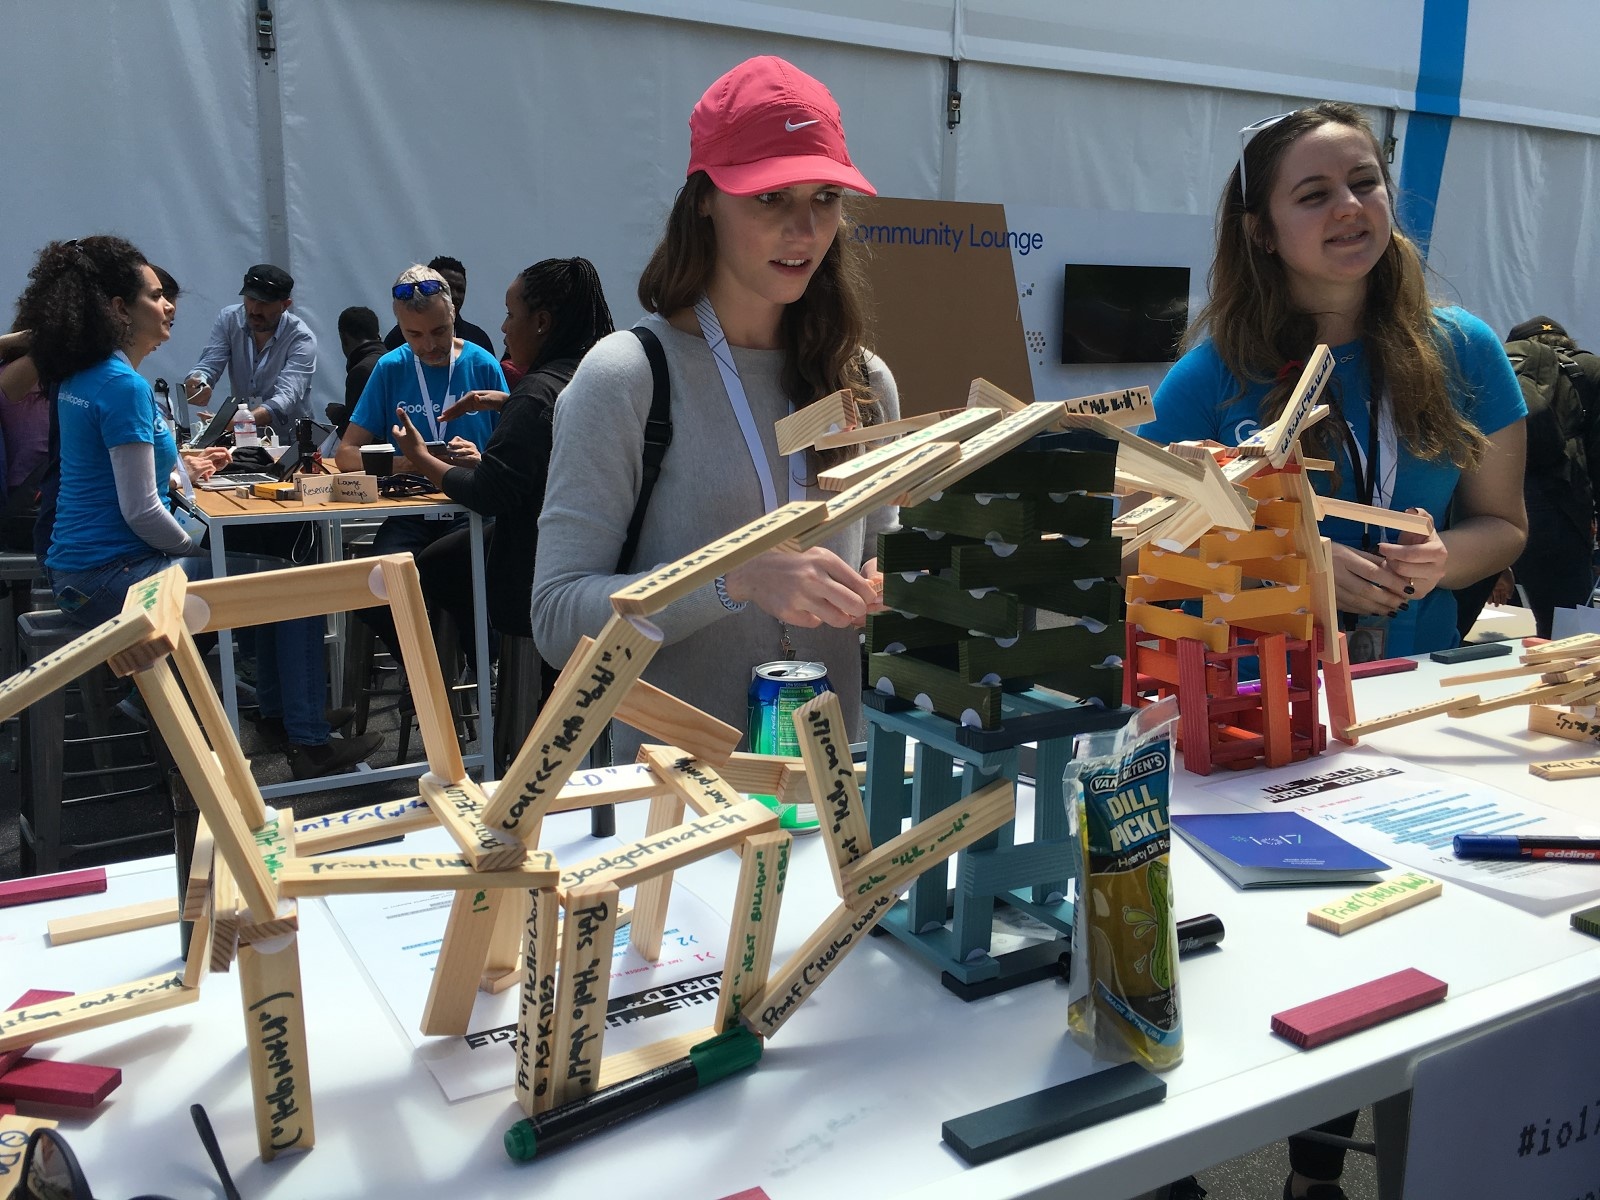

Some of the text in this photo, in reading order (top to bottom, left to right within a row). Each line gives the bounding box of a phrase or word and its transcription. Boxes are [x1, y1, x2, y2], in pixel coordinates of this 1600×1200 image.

[847, 215, 1044, 256] ommunity Lounge
[303, 483, 334, 497] Reserved
[1106, 784, 1158, 820] DILL
[1109, 806, 1170, 852] PICKL
[1545, 850, 1596, 860] edding
